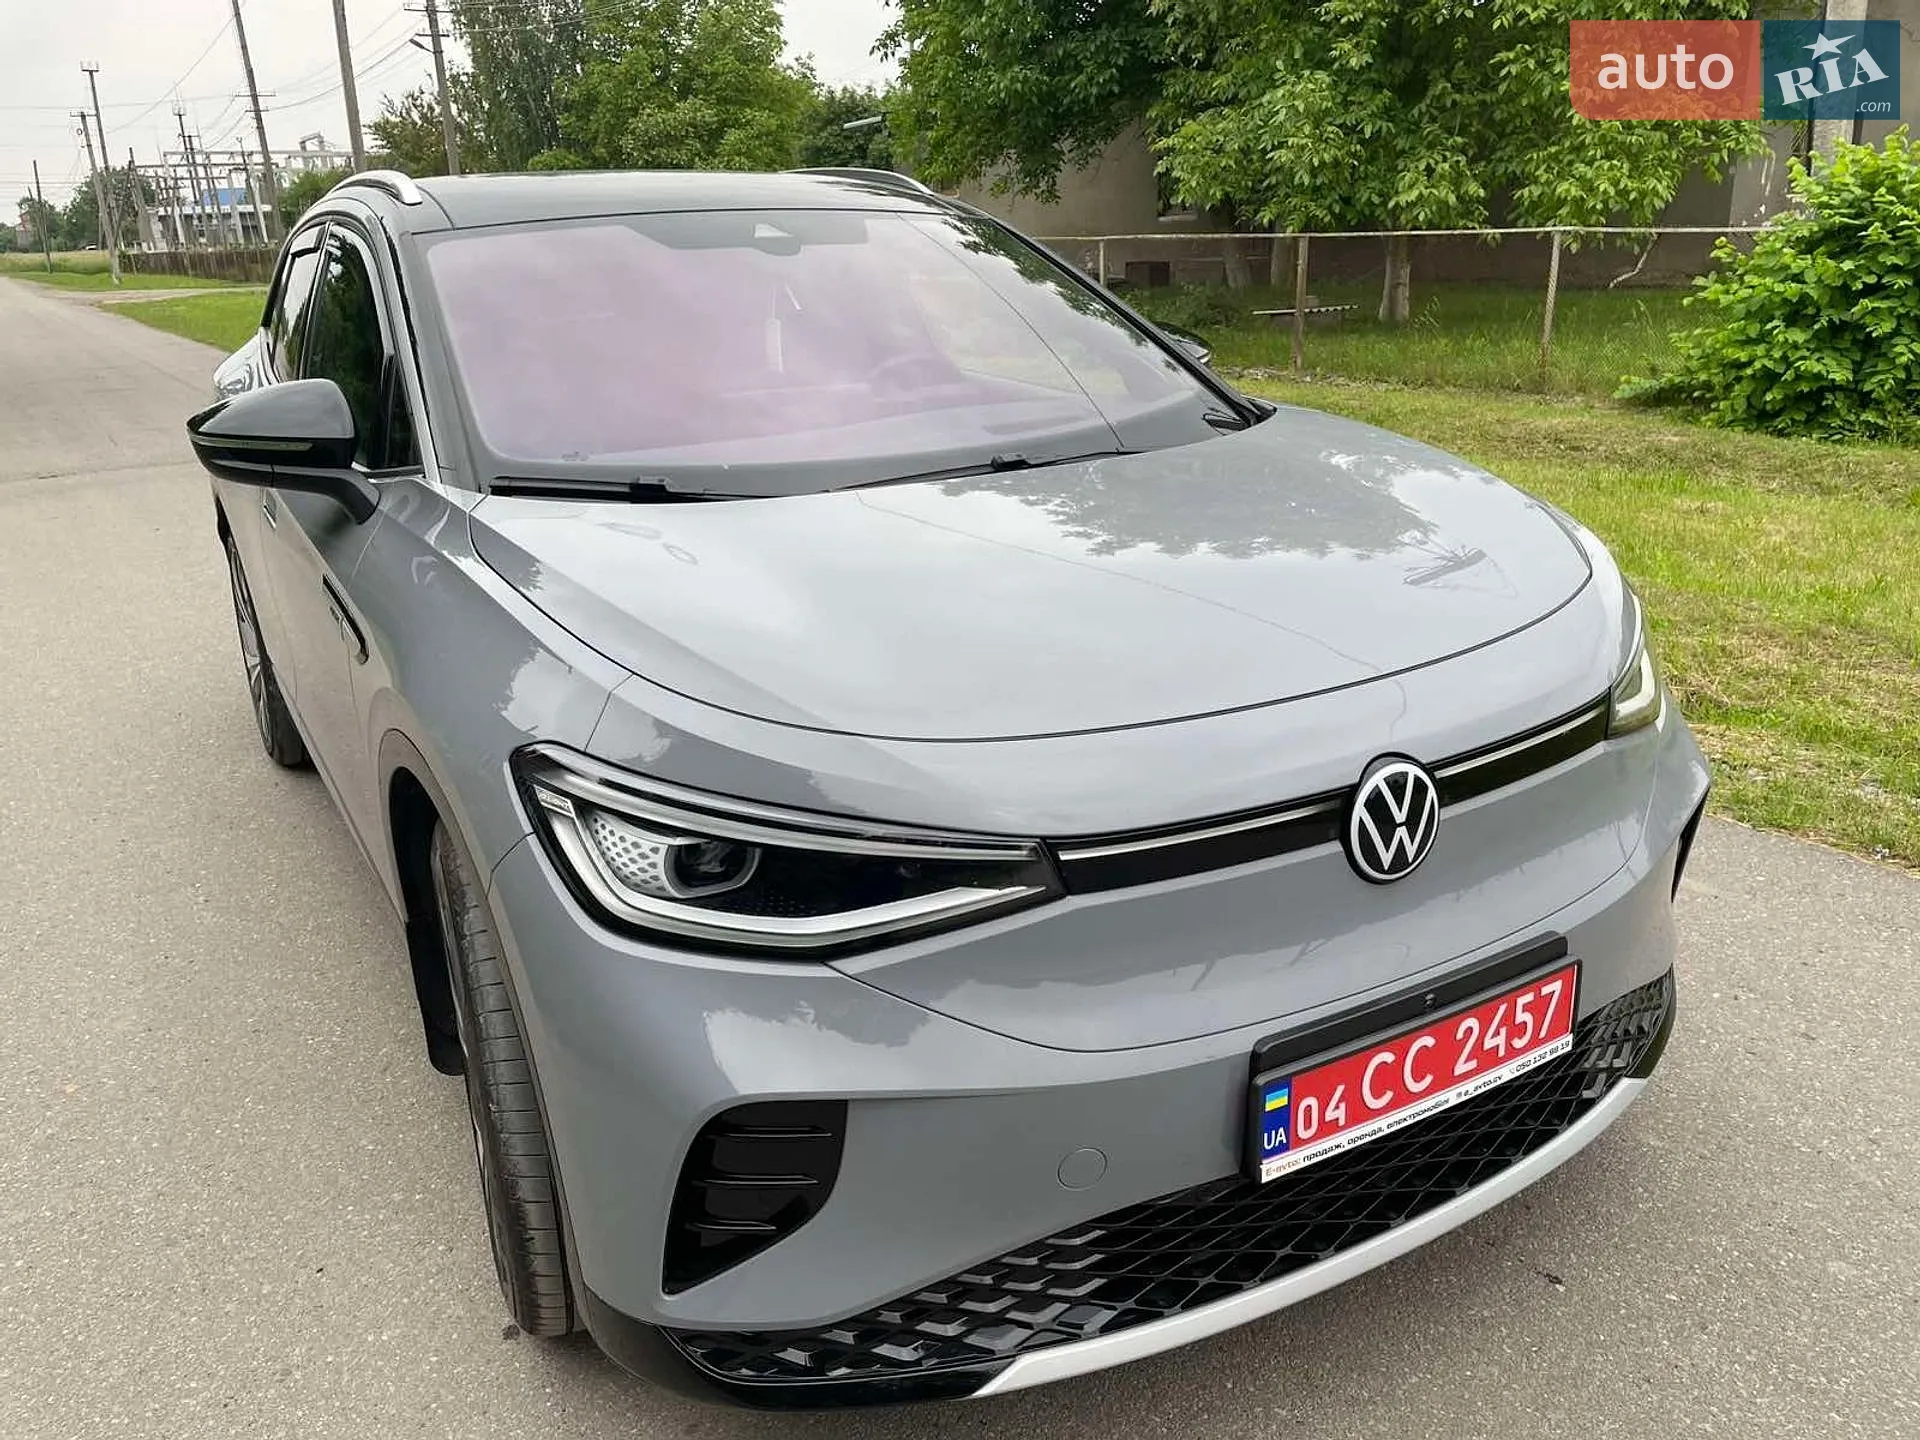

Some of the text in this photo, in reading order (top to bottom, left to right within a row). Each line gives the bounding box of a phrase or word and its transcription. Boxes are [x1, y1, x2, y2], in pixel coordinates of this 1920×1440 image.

[1353, 764, 1437, 876] VW
[1296, 979, 1564, 1139] 04 CC 2457
[1263, 1127, 1287, 1150] UA
[1303, 1142, 1345, 1162] продаж,
[1347, 1126, 1385, 1146] оренда,
